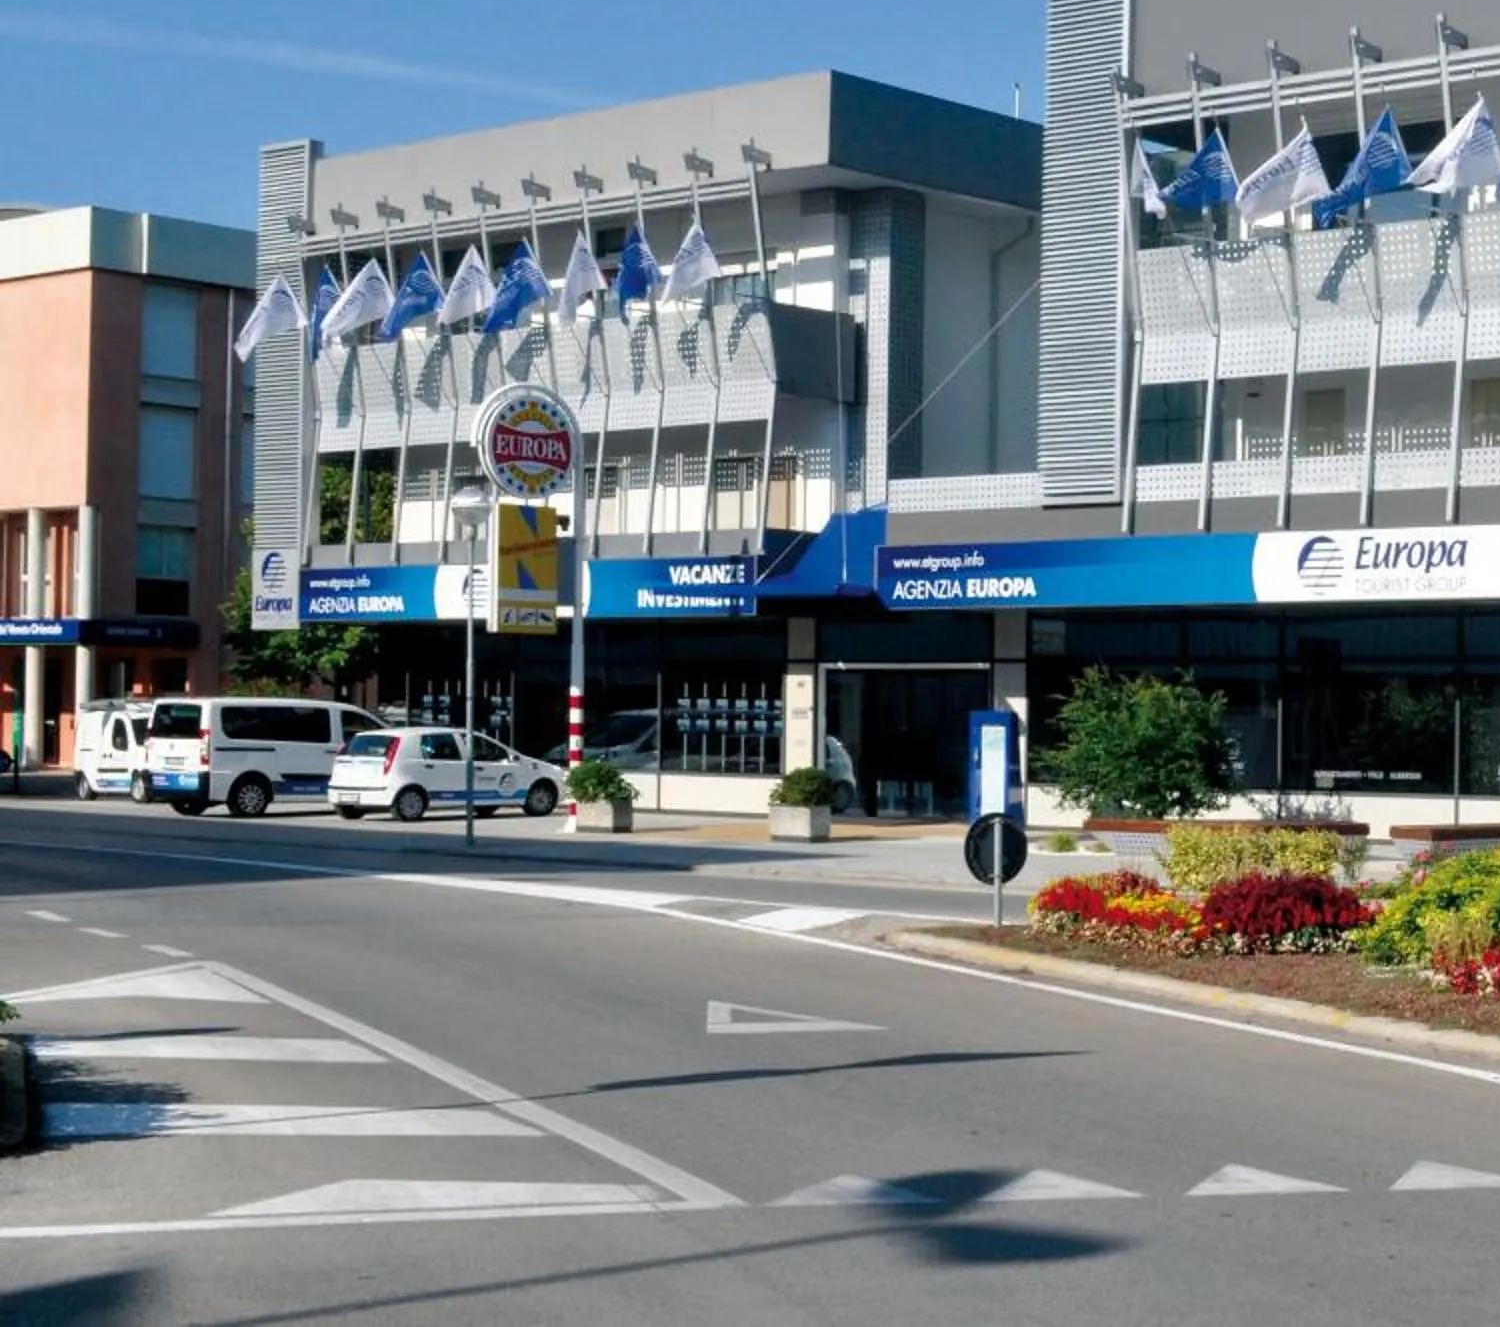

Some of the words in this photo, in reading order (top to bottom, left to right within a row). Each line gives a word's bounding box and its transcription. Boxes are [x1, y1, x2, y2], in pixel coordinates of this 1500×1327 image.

[495, 434, 567, 462] EUROPA
[1355, 536, 1468, 573] Europa
[668, 564, 745, 586] VACANZE
[1355, 578, 1409, 593] TOURIST
[1415, 576, 1467, 592] GROUP
[892, 579, 963, 599] AGENZIA
[966, 577, 1037, 598] EUROPA
[255, 596, 293, 613] Europa
[308, 596, 355, 612] AGENZIA
[358, 595, 405, 612] EUROPA
